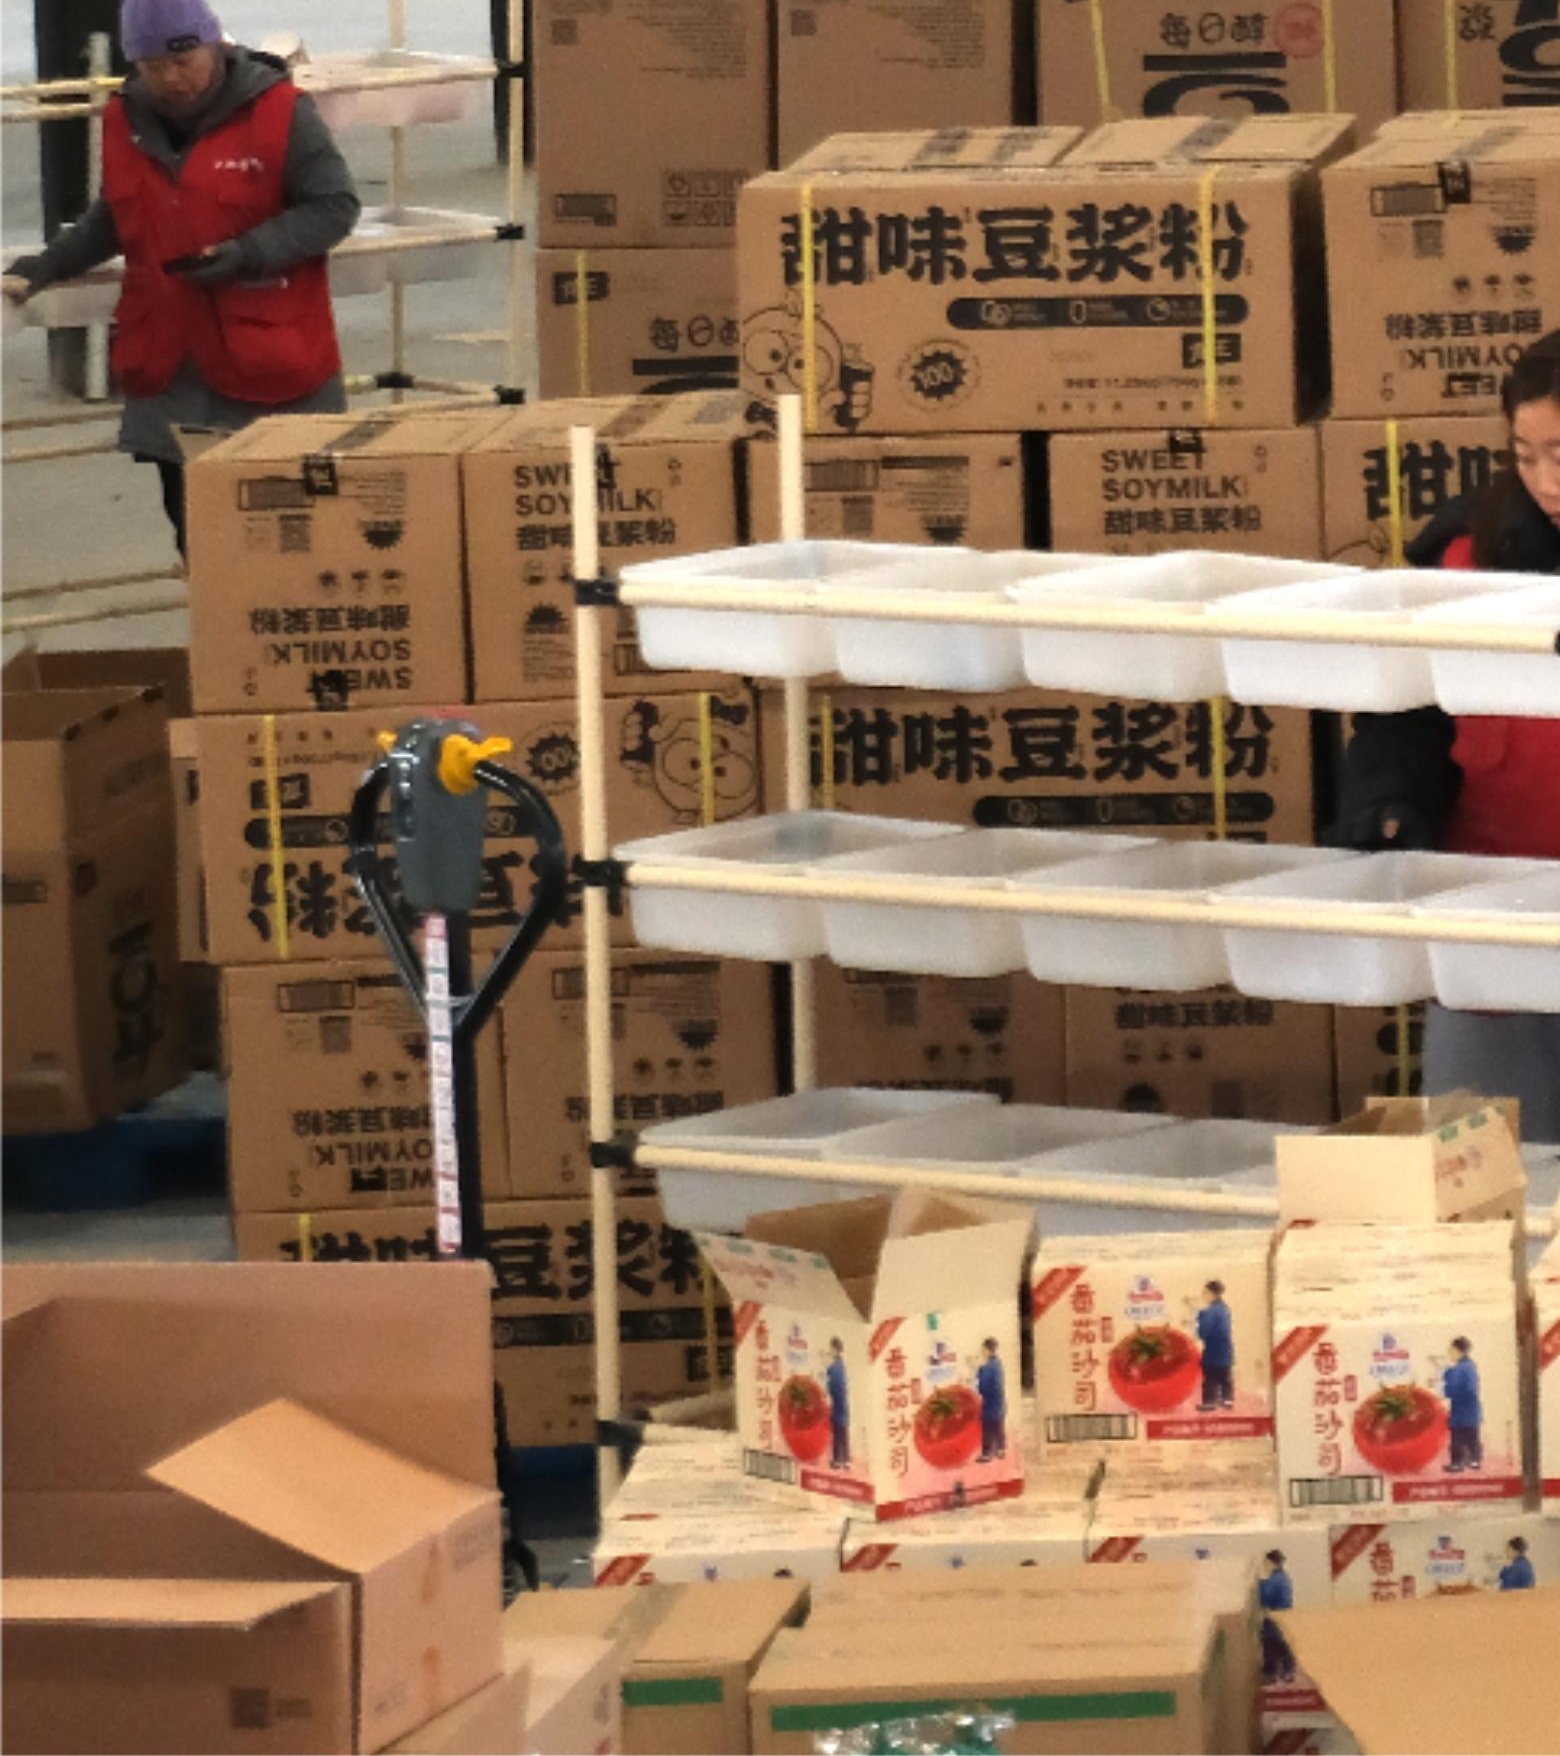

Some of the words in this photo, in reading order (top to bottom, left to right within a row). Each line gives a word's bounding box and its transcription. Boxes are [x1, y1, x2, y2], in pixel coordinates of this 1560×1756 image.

[1160, 10, 1268, 44] 每日醇
[779, 200, 1249, 285] 甜味豆浆粉
[1384, 310, 1544, 339] 甜味豆浆粉
[1102, 475, 1246, 502] SOYMILK
[1103, 506, 1260, 537] 甜味豆浆粉
[249, 604, 412, 635] 甜味豆浆粉
[271, 639, 414, 666] SOYMILK
[1069, 1281, 1099, 1412] 番茄沙司
[883, 1348, 914, 1475] 番茄沙司
[1312, 1341, 1345, 1477] 番茄沙司
